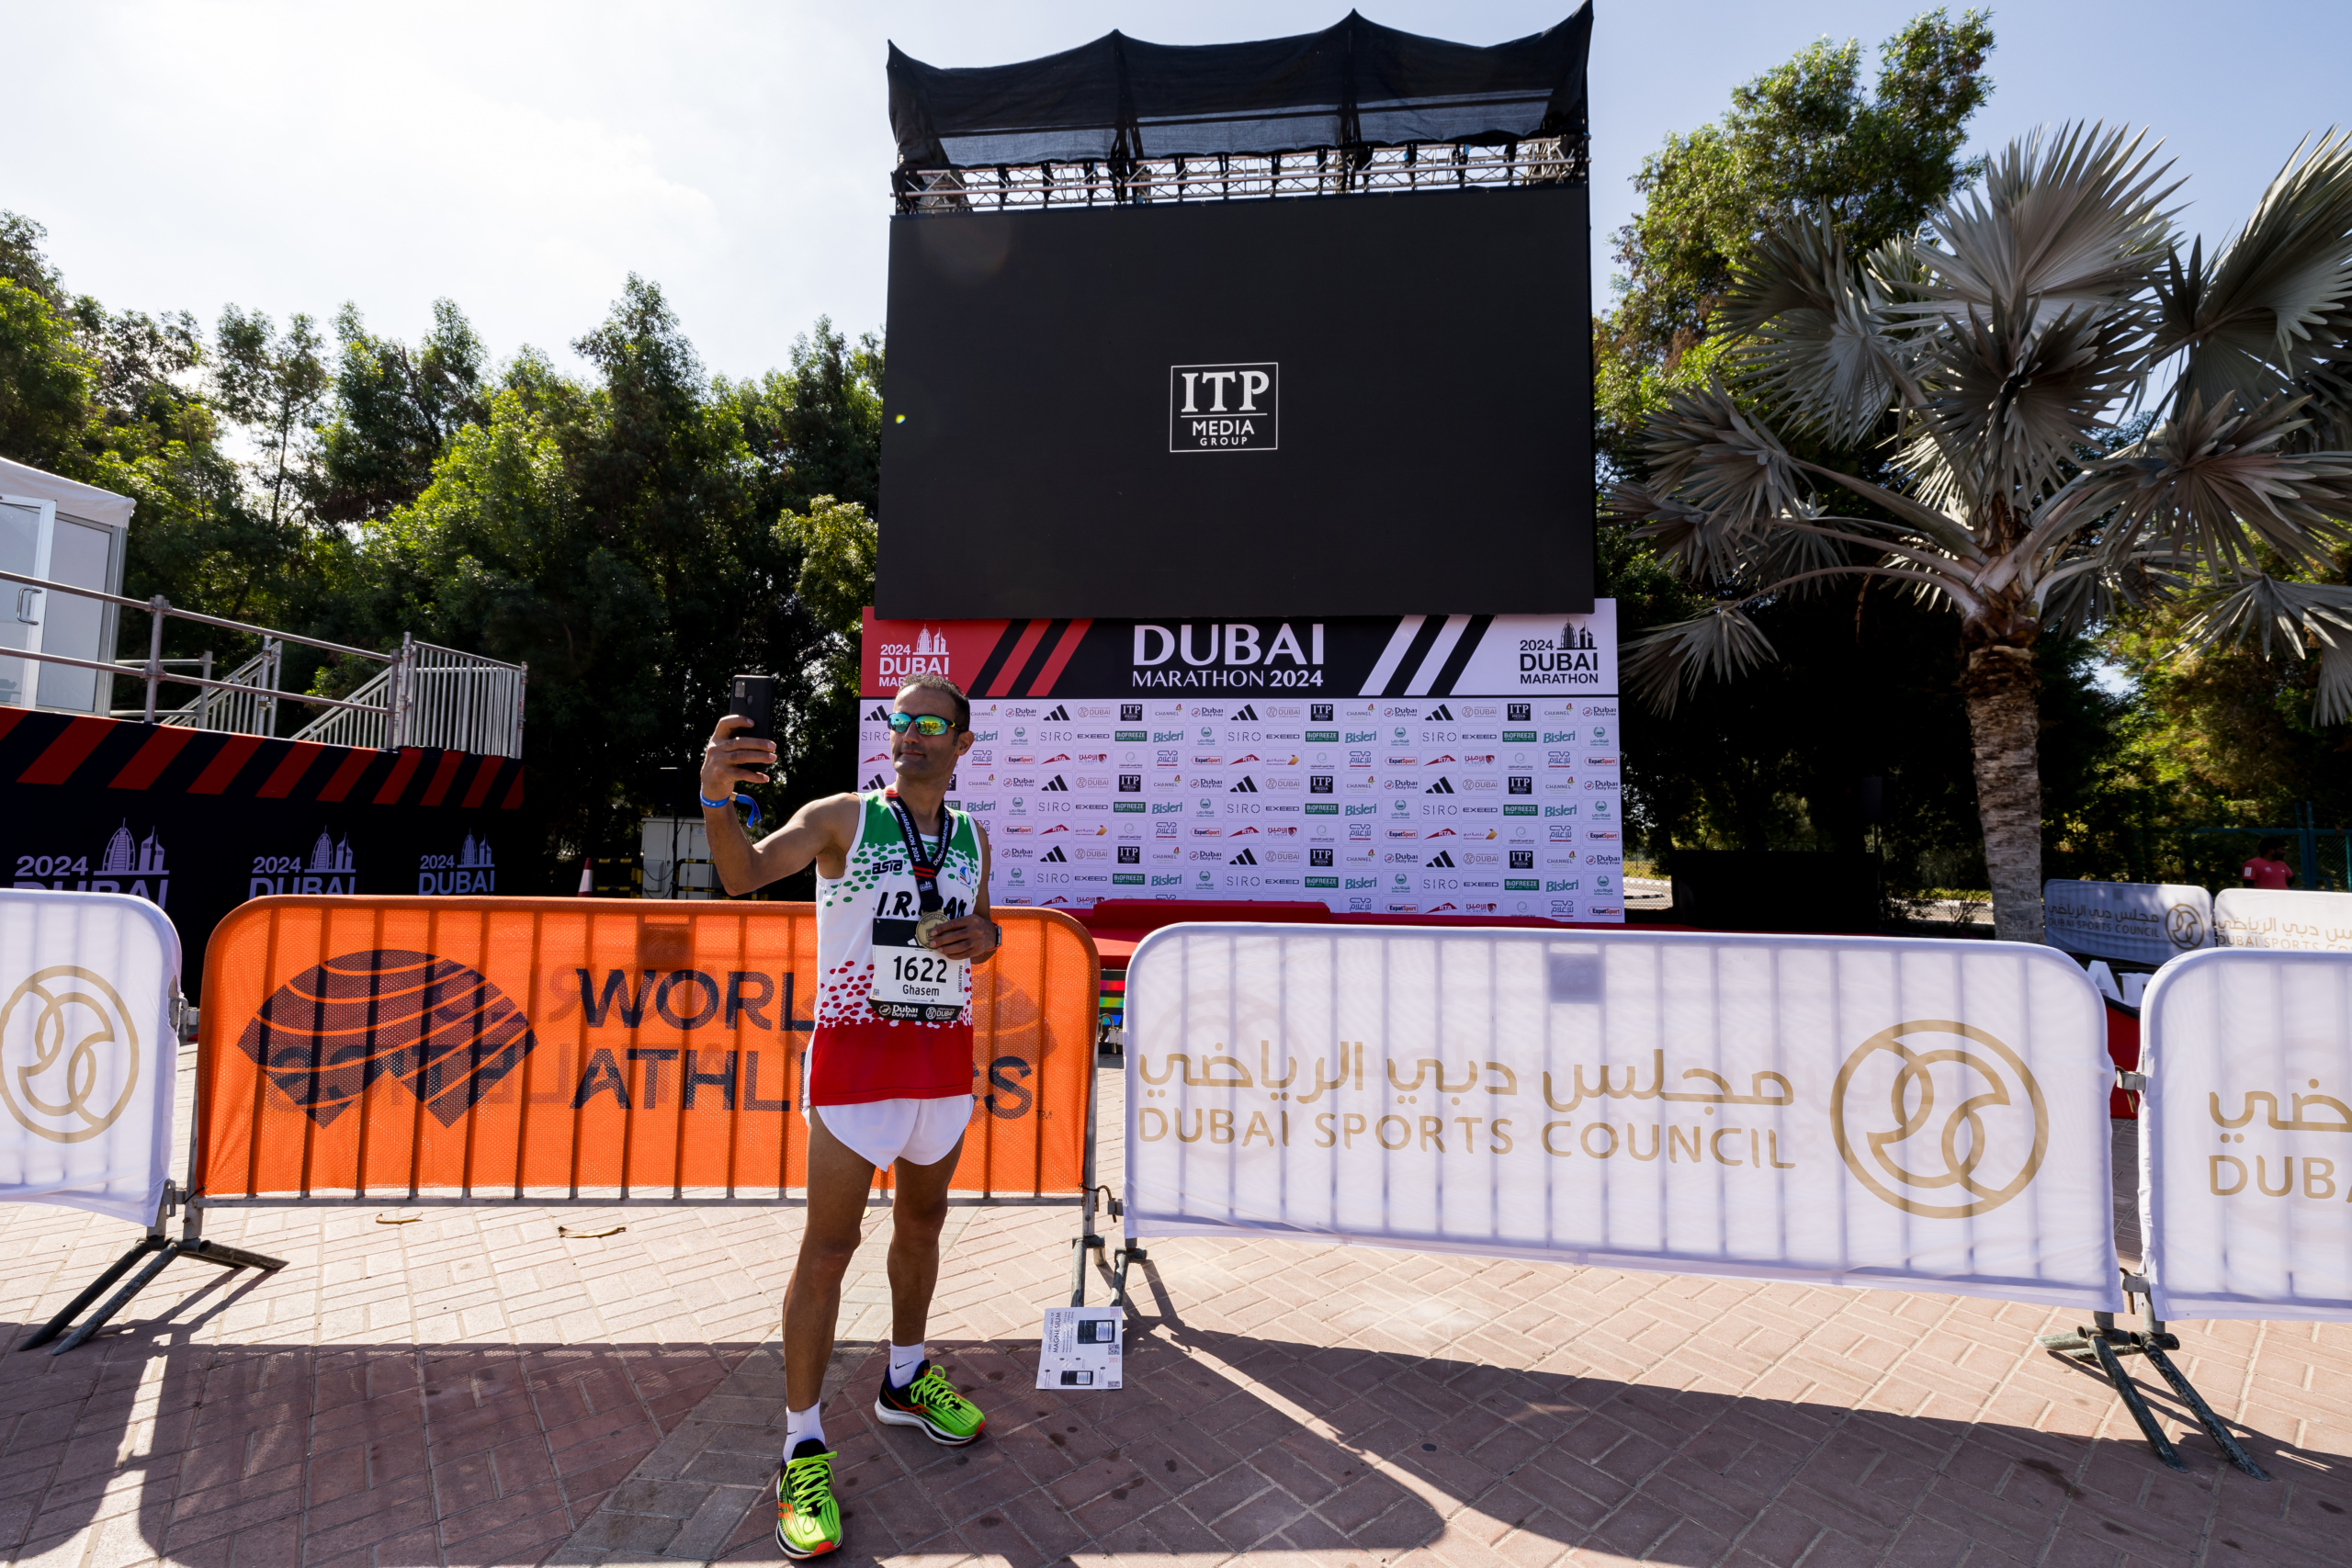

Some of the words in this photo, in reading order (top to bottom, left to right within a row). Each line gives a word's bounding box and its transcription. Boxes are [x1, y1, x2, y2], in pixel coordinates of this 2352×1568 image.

[1181, 370, 1270, 412] ITP
[1193, 419, 1255, 436] MEDIA
[1200, 436, 1248, 446] GROUP
[880, 644, 910, 655] 2024
[1133, 623, 1324, 666] DUBAI
[1520, 639, 1554, 650] 2024
[879, 657, 949, 675] DUBAI
[1520, 652, 1598, 671] DUBAI
[1132, 670, 1264, 687] MARATHON
[1269, 670, 1324, 687] 2024
[1520, 673, 1599, 684] MARATHON
[1040, 732, 1072, 741] SIRO
[1153, 731, 1183, 742] Bisleri
[1228, 732, 1261, 741] SIRO
[1345, 731, 1376, 743] Bisleri
[1422, 732, 1456, 741] SIRO
[1544, 731, 1576, 743] Bisleri
[1312, 777, 1331, 785] ITP
[1510, 778, 1530, 786] ITP
[967, 801, 996, 812] Bisleri
[1038, 802, 1070, 811] SIRO
[1152, 802, 1182, 814] Bisleri
[1227, 804, 1261, 814] SIRO
[1345, 804, 1376, 816] Bisleri
[1423, 806, 1457, 815] SIRO
[1544, 805, 1577, 817] Bisleri
[899, 812, 917, 846] MARATHON
[910, 846, 922, 863] 2024
[933, 847, 944, 866] DUBAI
[1120, 848, 1138, 856] ITP
[1313, 850, 1331, 858] ITP
[15, 855, 88, 876] 2024
[252, 856, 301, 874] 2024
[419, 854, 455, 870] 2024
[418, 870, 494, 896] DUBAI
[1037, 874, 1069, 883] SIRO
[1151, 874, 1182, 886] Bisleri
[1227, 876, 1260, 886] SIRO
[1345, 877, 1376, 889] Bisleri
[1423, 879, 1458, 889] SIRO
[248, 876, 356, 898] DUBAI
[1546, 880, 1578, 892] Bisleri
[2088, 908, 2112, 921] دبي
[2048, 918, 2075, 928] DUBAI
[2076, 920, 2112, 932] SPORTS
[2115, 924, 2160, 938] COUNCIL
[2217, 934, 2258, 947] DUBAI
[893, 956, 947, 983] 1622
[902, 984, 940, 997] Ghasem
[575, 968, 816, 1032] WORL
[892, 1004, 919, 1013] Dubai
[1138, 1040, 1364, 1105] الرياضي
[1386, 1056, 1518, 1108] دبي
[1543, 1048, 1794, 1116] مجلس
[1138, 1106, 1291, 1148] DUBAI
[1315, 1111, 1514, 1155] SPORTS
[1541, 1120, 1797, 1169] COUNCIL
[2209, 1155, 2352, 1203] DUB
[1052, 1312, 1061, 1353] MAGNESIUM
